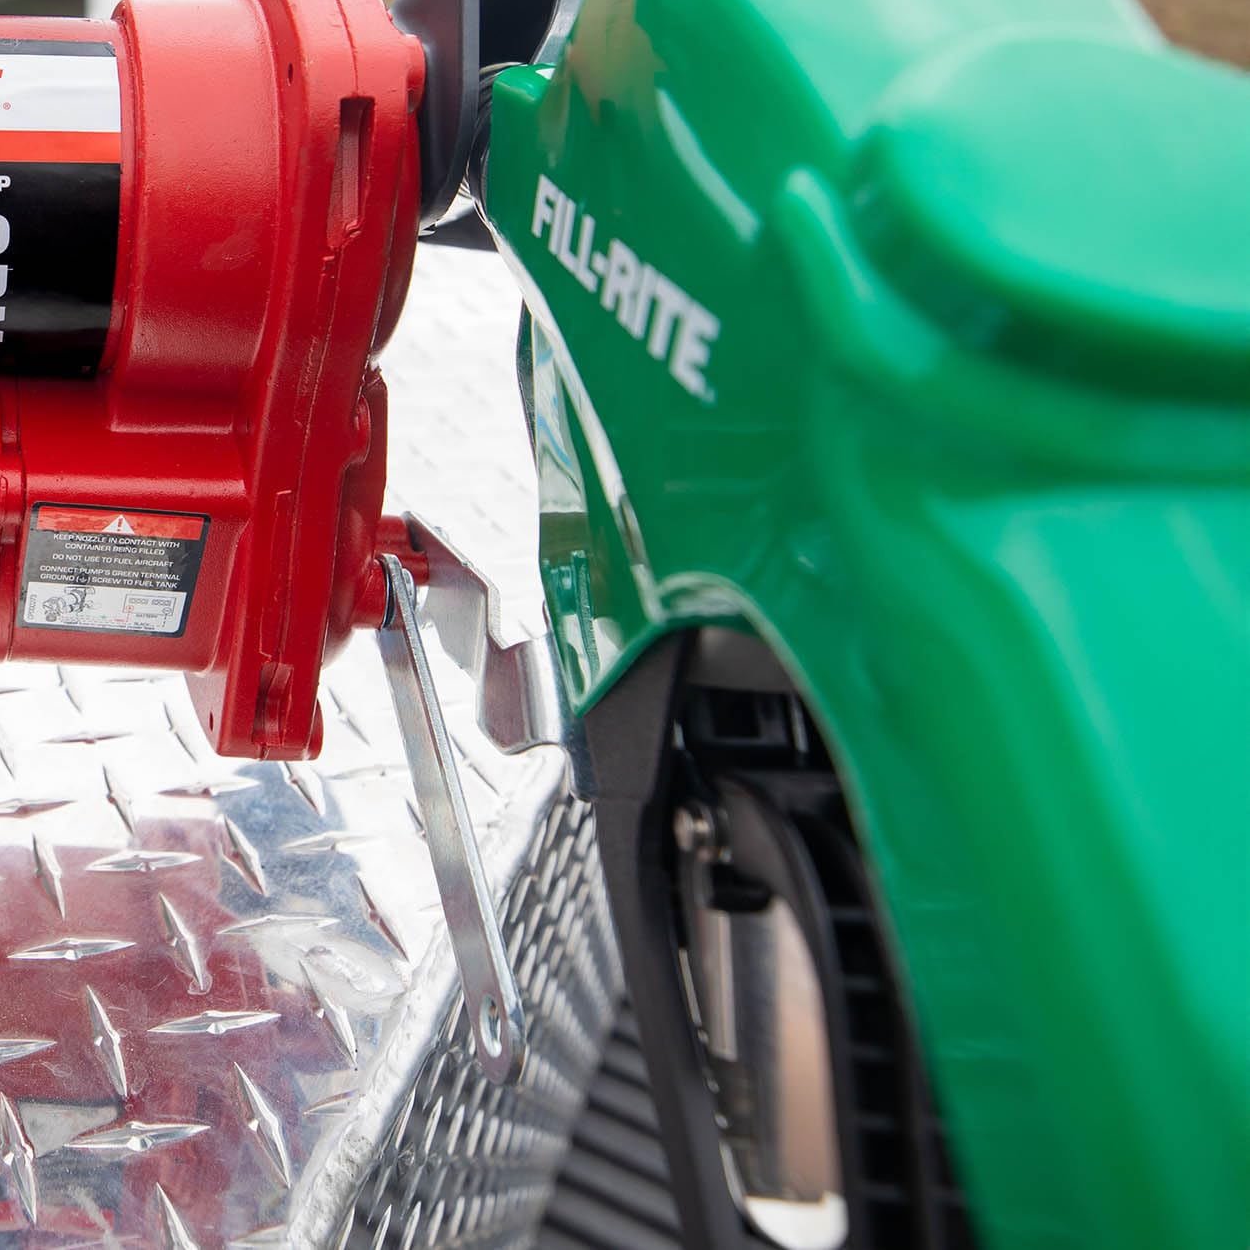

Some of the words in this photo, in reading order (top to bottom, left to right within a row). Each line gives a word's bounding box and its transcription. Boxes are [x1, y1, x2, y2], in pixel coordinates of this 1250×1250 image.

[531, 173, 721, 398] FILL-RITE
[53, 533, 74, 541] KEEP
[74, 535, 107, 544] NOZZLE
[119, 538, 157, 547] CONTACT
[158, 541, 181, 549] WITH
[64, 543, 112, 552] CONTAINER
[112, 546, 138, 554] BEING
[138, 548, 166, 556] FILLED
[52, 553, 65, 561] DO
[66, 554, 83, 562] NOT
[113, 557, 133, 565] FUEL
[134, 559, 174, 568] AIRCRAFT
[39, 565, 79, 574] CONNECT
[79, 567, 111, 576] PUMP'S
[111, 570, 140, 578] GREEN
[140, 572, 181, 581] TERMINAL
[40, 573, 75, 582] GROUND
[91, 576, 124, 585] SCREW
[123, 578, 134, 586] TO
[134, 579, 154, 587] FUEL
[155, 581, 178, 589] TANK
